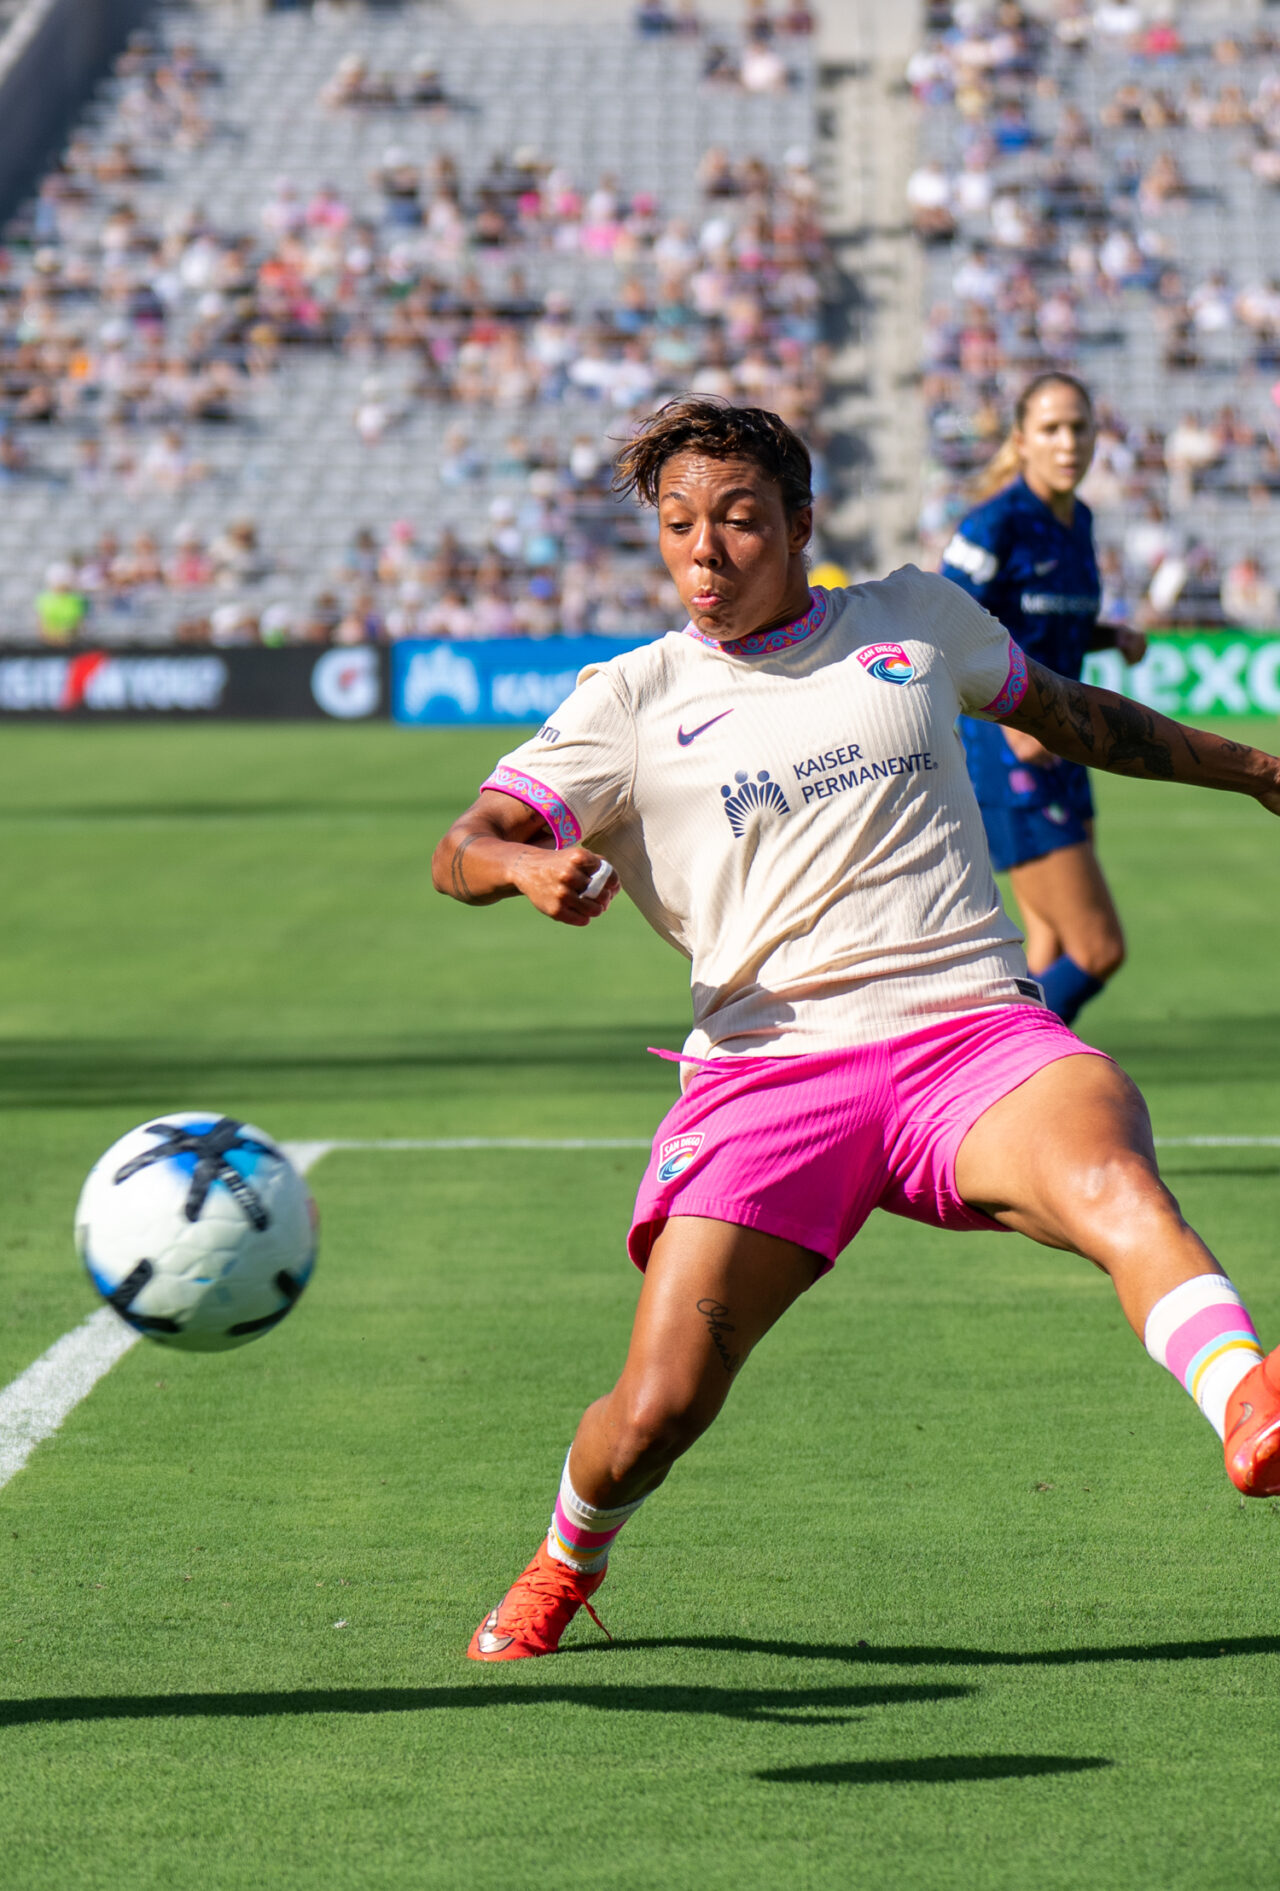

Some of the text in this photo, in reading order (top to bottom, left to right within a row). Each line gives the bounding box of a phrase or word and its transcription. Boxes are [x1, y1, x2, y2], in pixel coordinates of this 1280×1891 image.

[310, 646, 380, 718] G
[792, 743, 864, 781] KAISER
[801, 752, 934, 804] PERMANENTE
